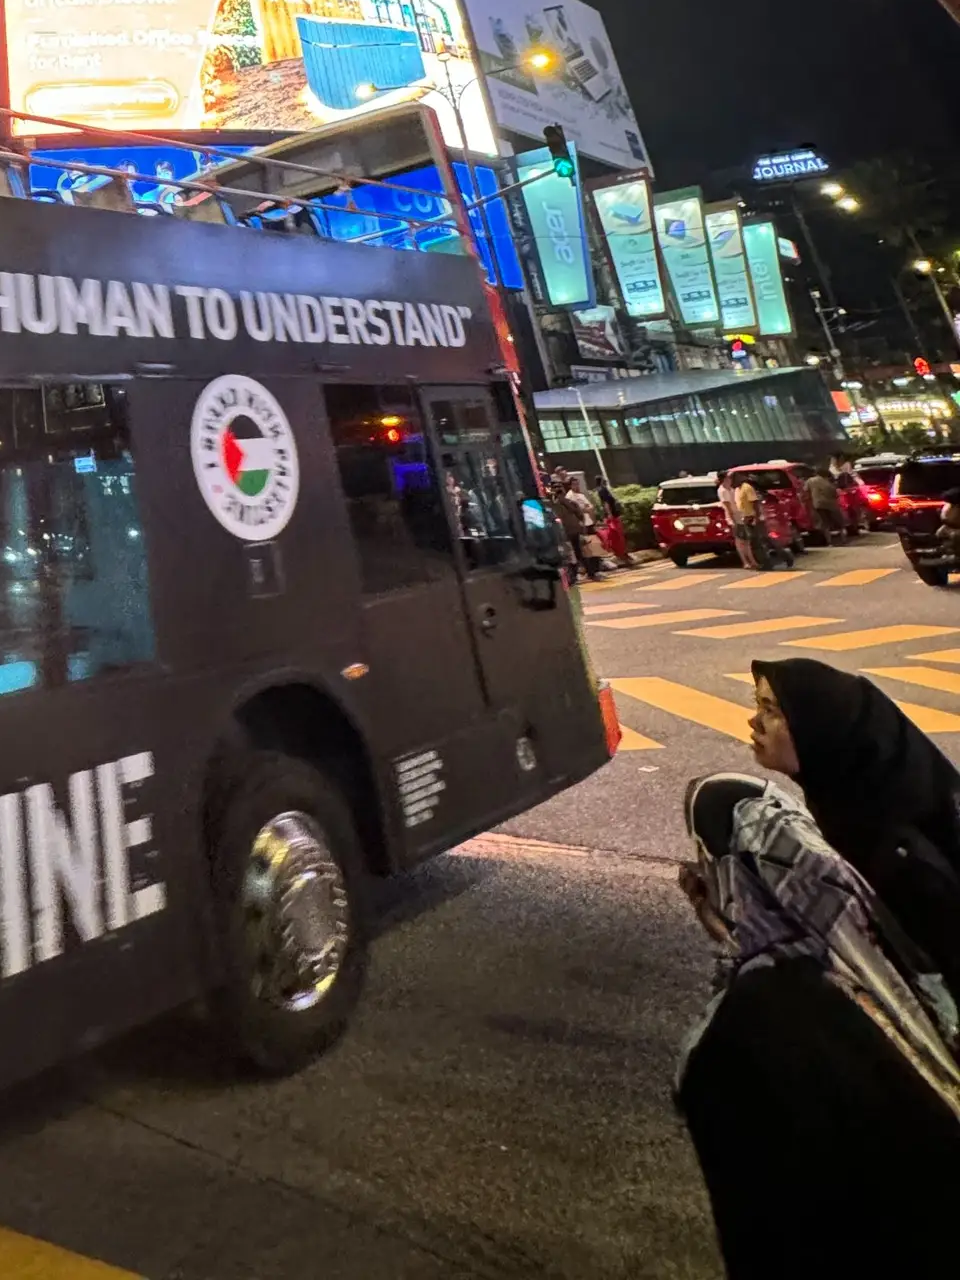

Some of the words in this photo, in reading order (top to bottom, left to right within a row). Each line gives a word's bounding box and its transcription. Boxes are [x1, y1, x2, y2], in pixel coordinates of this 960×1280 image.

[753, 158, 829, 180] JOURNAL
[542, 200, 575, 265] acer
[176, 284, 238, 342] TO
